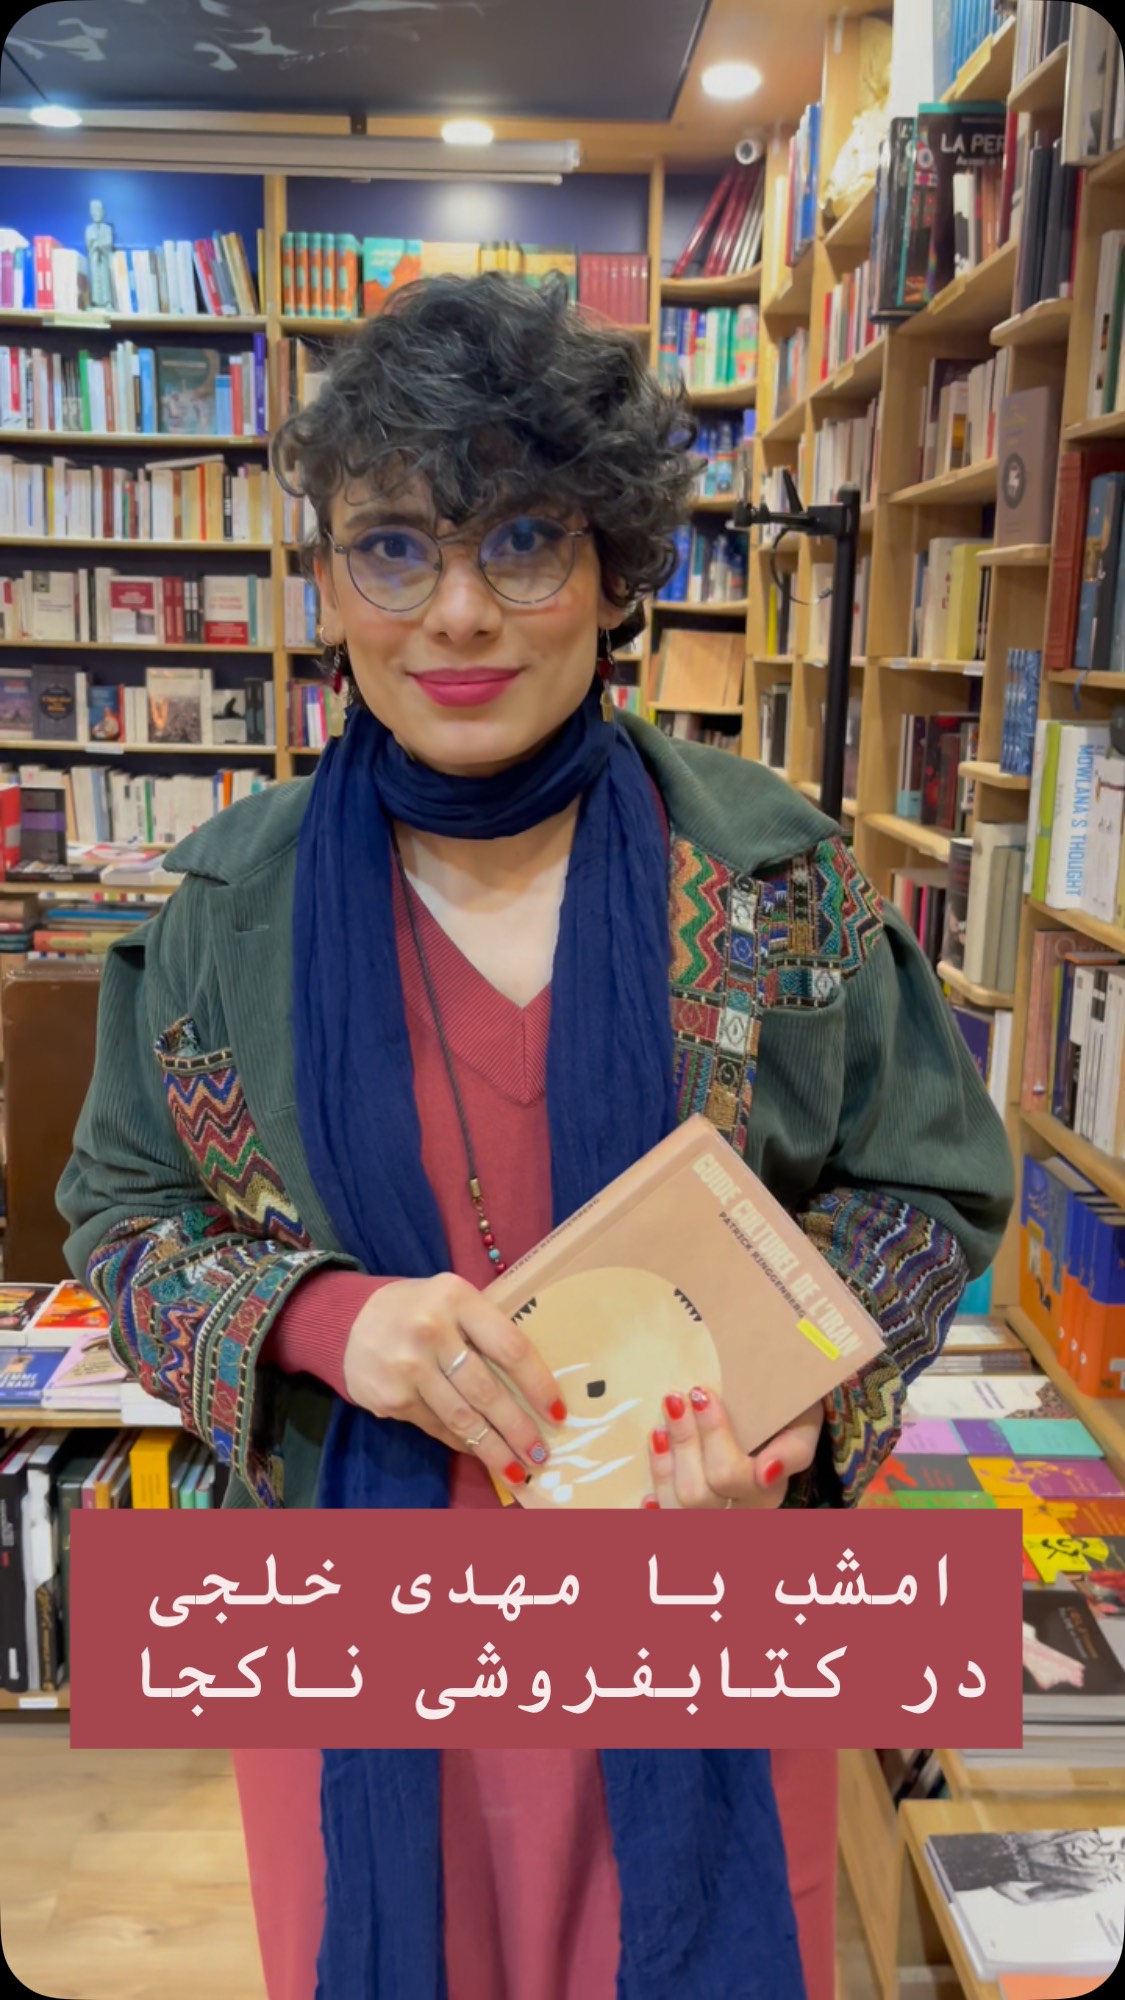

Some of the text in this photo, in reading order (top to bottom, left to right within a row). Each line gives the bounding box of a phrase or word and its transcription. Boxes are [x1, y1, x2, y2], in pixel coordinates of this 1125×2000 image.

[939, 132, 966, 154] LA
[1066, 834, 1089, 897] THOUGHT
[692, 1152, 864, 1358] GUIDE CULTUREL DE L'IRAN
[717, 1211, 806, 1319] PATRICK RINGGENBERG
